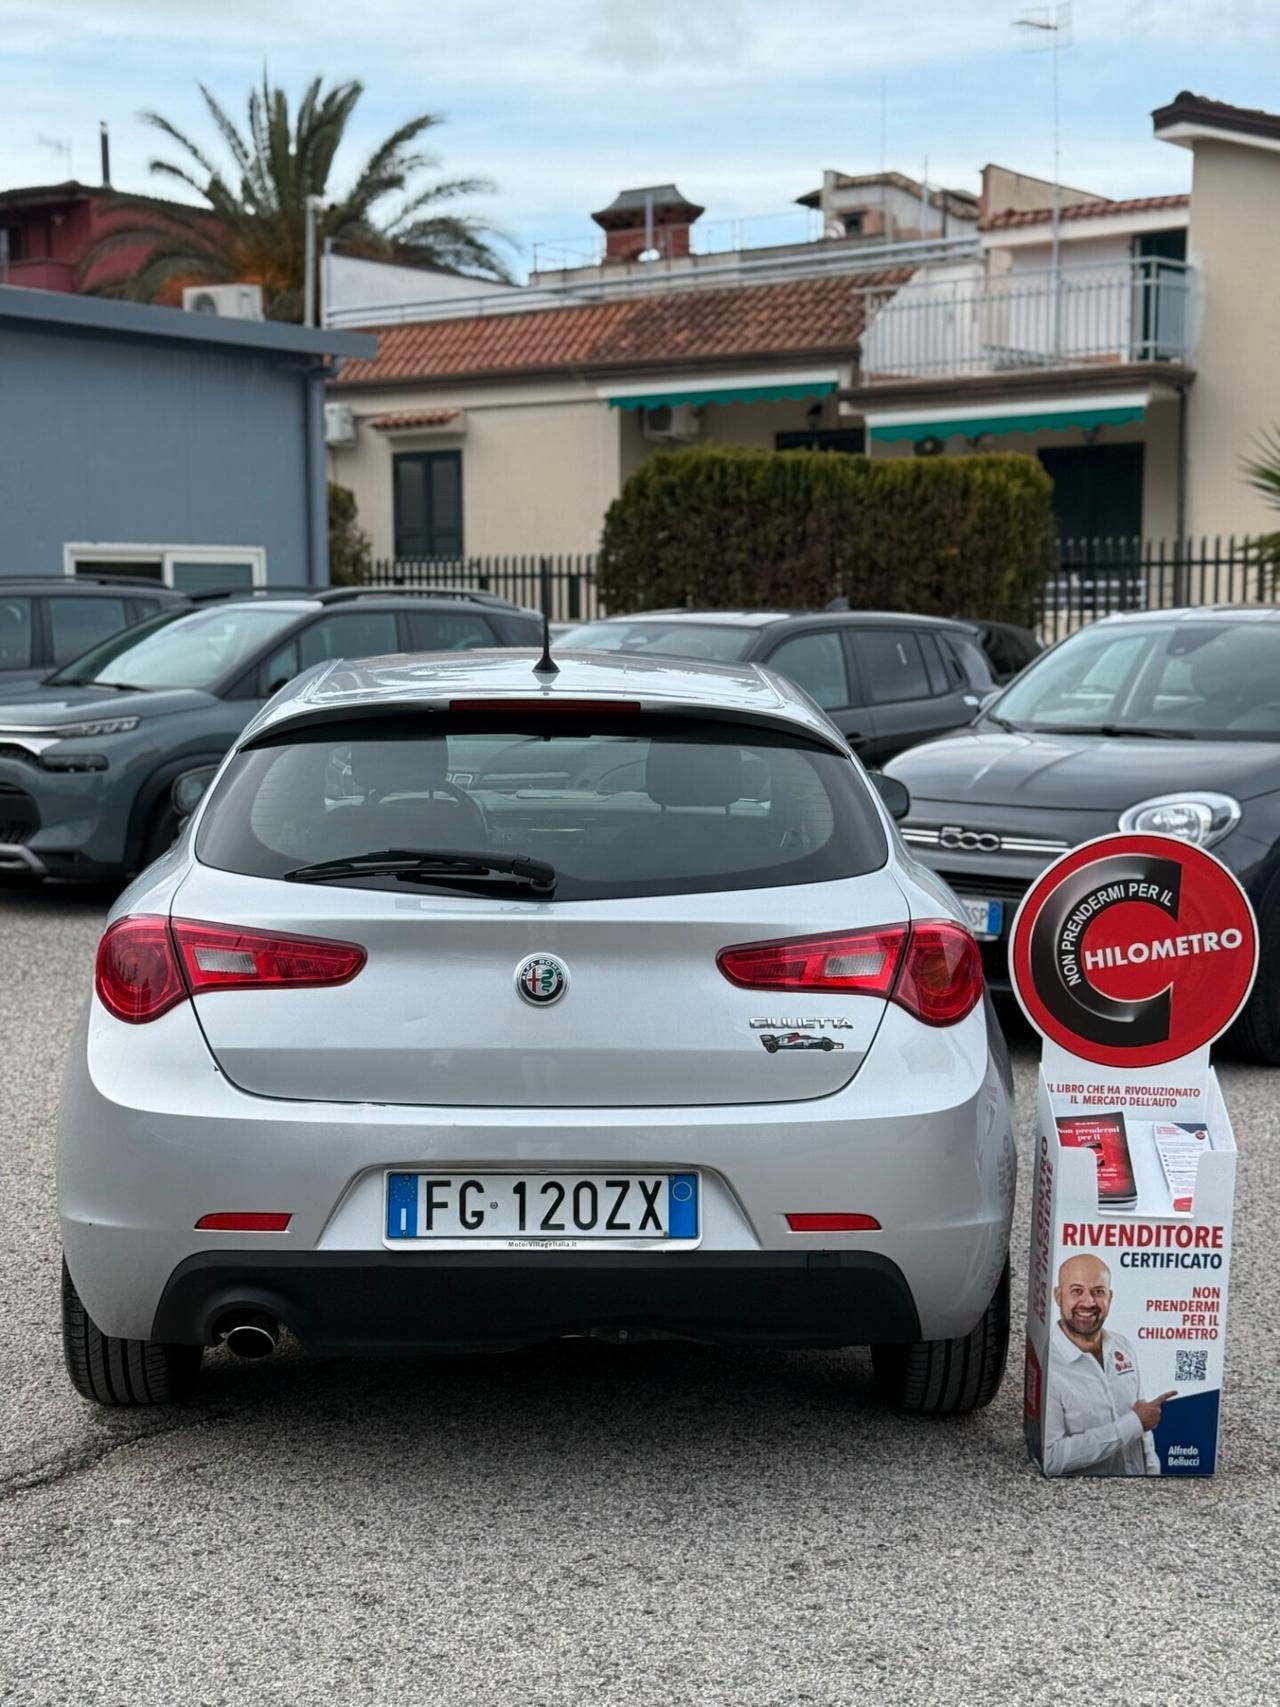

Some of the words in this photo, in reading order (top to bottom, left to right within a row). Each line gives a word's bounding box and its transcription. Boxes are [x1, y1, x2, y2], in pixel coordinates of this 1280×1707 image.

[940, 827, 1000, 851] 500
[1129, 883, 1159, 900] PER
[1160, 890, 1173, 906] IL
[1062, 884, 1124, 950] PRENDERMI
[1061, 955, 1081, 987] NON
[749, 1017, 854, 1029] GIULIETTA
[1057, 1084, 1085, 1094] LIBRO
[1087, 1085, 1106, 1094] CHE
[1107, 1085, 1120, 1094] HA
[1125, 1086, 1201, 1097] RIVOLUZIONATO
[1070, 1095, 1079, 1105] IL
[1083, 1095, 1127, 1106] MERCATO
[1129, 1097, 1178, 1108] DELL'AUTO
[1036, 1135, 1048, 1247] CONTRO
[426, 1180, 485, 1230] FG
[512, 1180, 664, 1231] 120ZX
[1041, 1157, 1054, 1275] INSIEME
[1062, 1223, 1224, 1249] RIVENDITORE
[1120, 1252, 1222, 1269] CERTIFICATO
[1192, 1287, 1221, 1299] NON
[1146, 1300, 1220, 1313] PRENDERMI
[1182, 1313, 1206, 1326] PER
[1208, 1314, 1219, 1326] IL
[1137, 1327, 1218, 1340] CHILOMETRO
[1168, 1445, 1198, 1456] Alfredo
[1168, 1456, 1199, 1467] Bellucci
